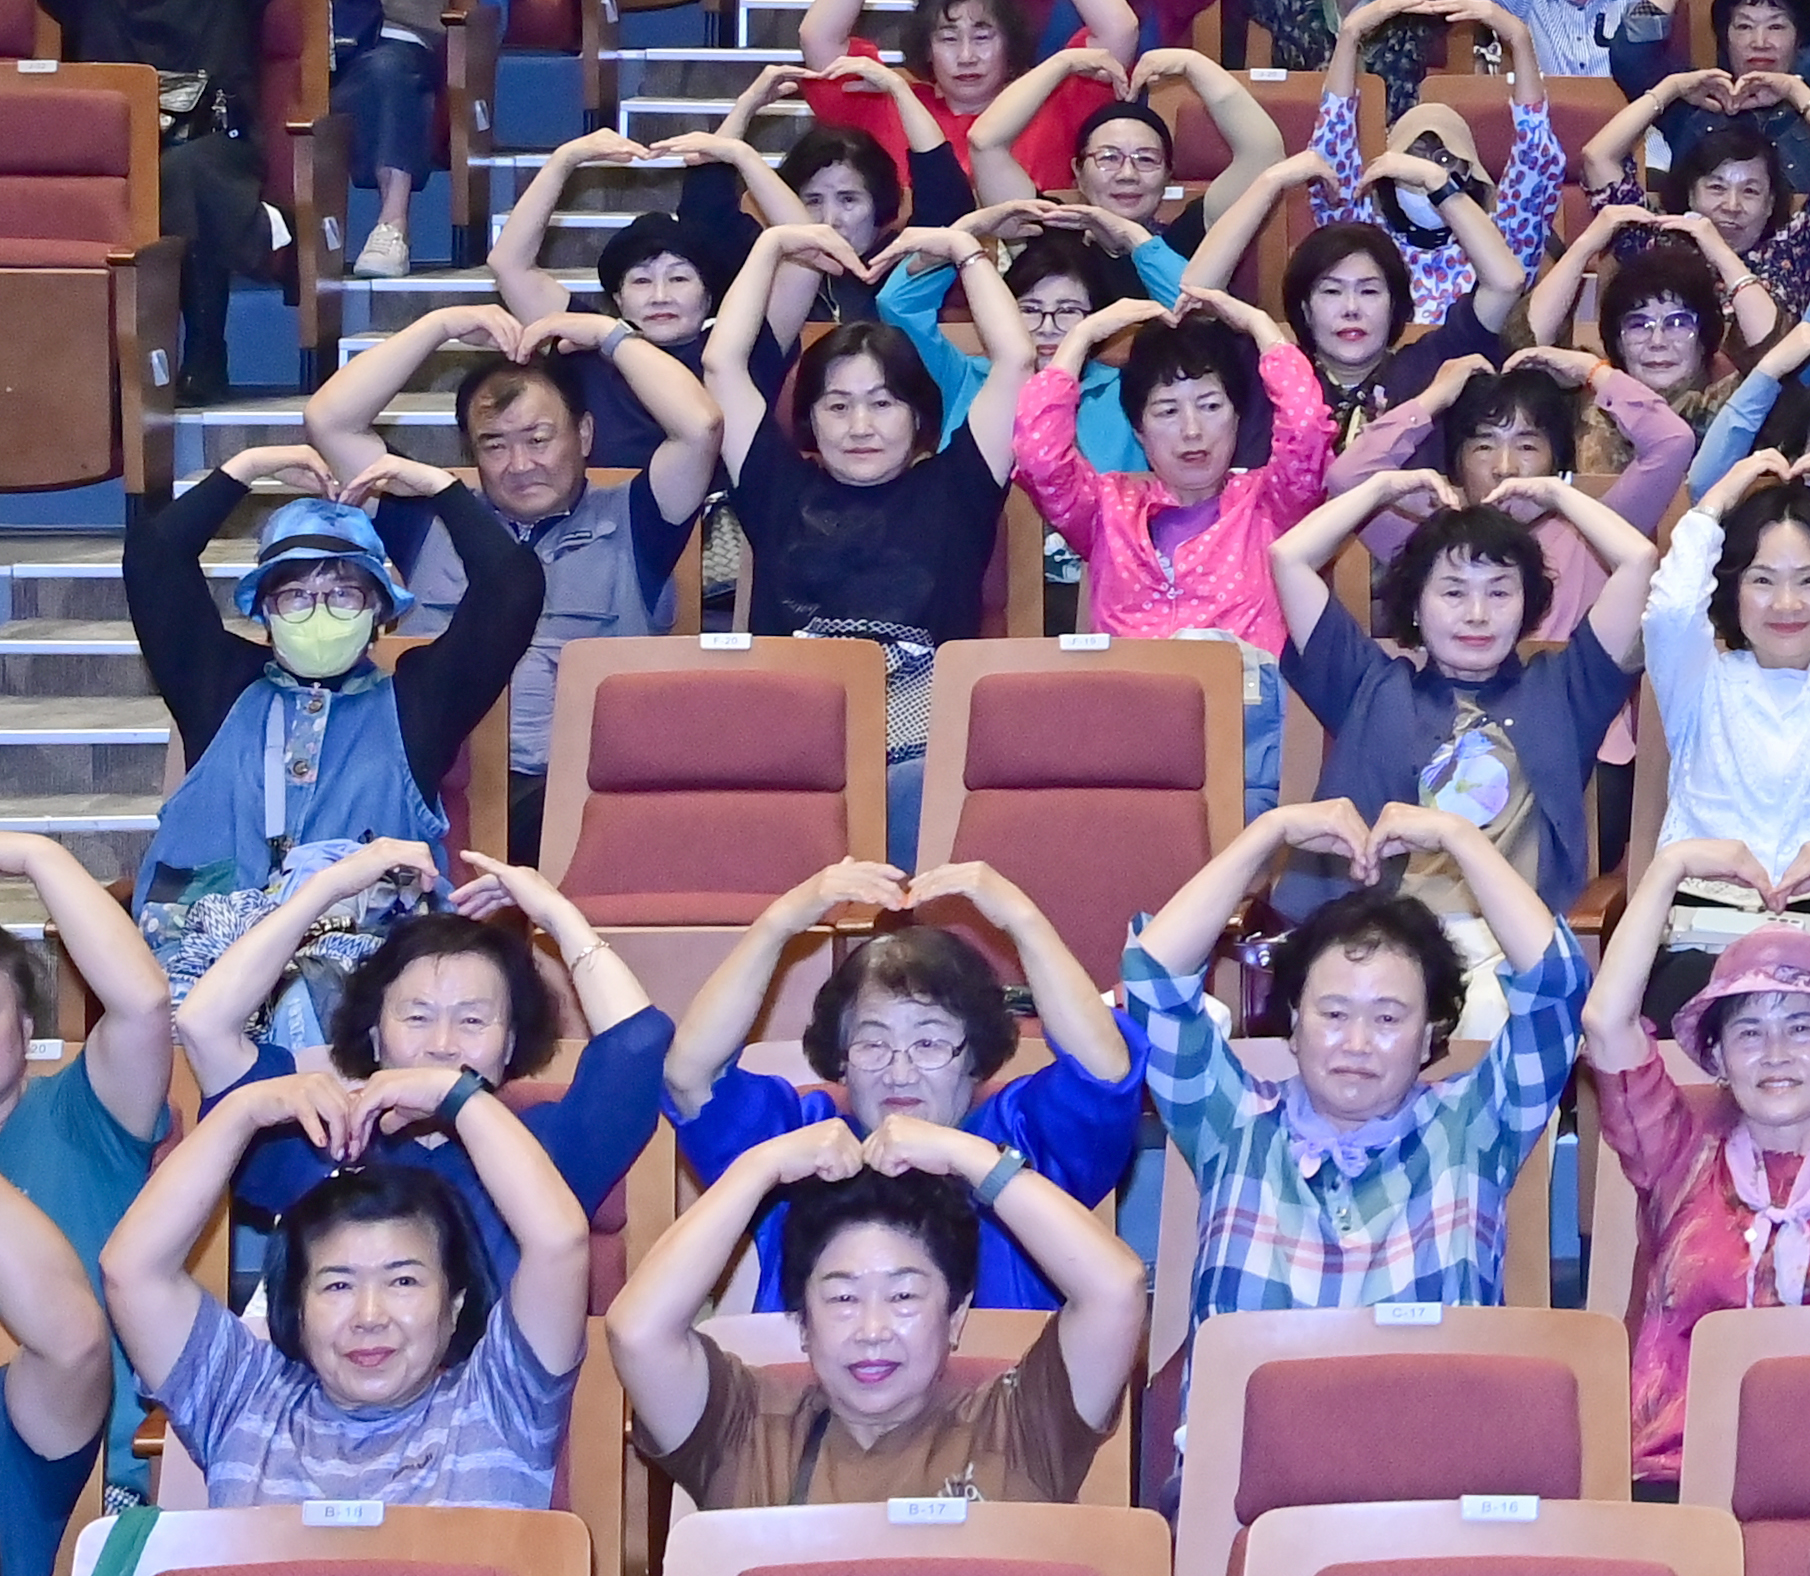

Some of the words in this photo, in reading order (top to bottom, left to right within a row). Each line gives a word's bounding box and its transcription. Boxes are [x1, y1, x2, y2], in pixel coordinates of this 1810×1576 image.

[30, 1043, 47, 1054] 20
[1391, 1307, 1426, 1318] C-17
[909, 1503, 946, 1515] B-17
